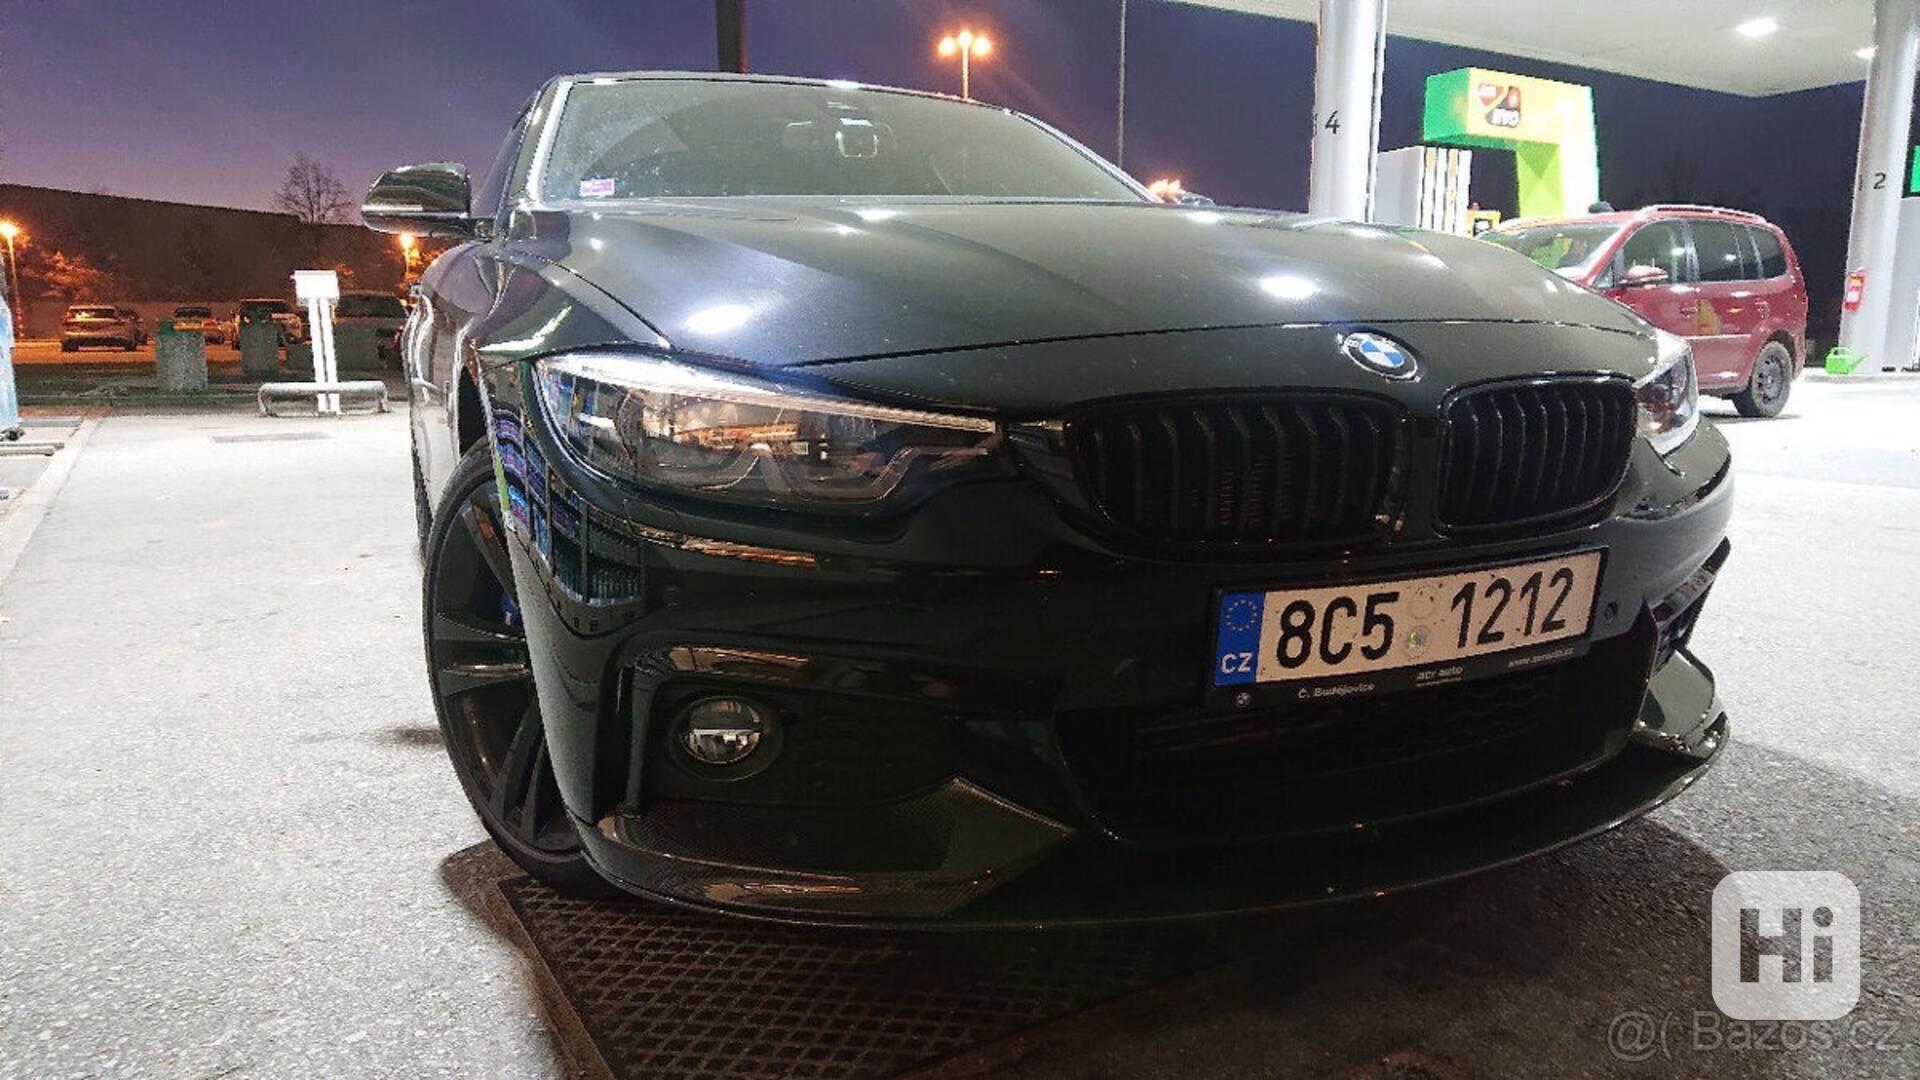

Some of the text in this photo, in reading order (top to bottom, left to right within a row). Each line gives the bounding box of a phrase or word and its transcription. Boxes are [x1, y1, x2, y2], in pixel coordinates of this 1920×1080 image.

[1325, 110, 1341, 135] 4
[1873, 171, 1887, 190] 2
[1275, 567, 1575, 670] 8C5 1212
[1220, 652, 1253, 674] CZ
